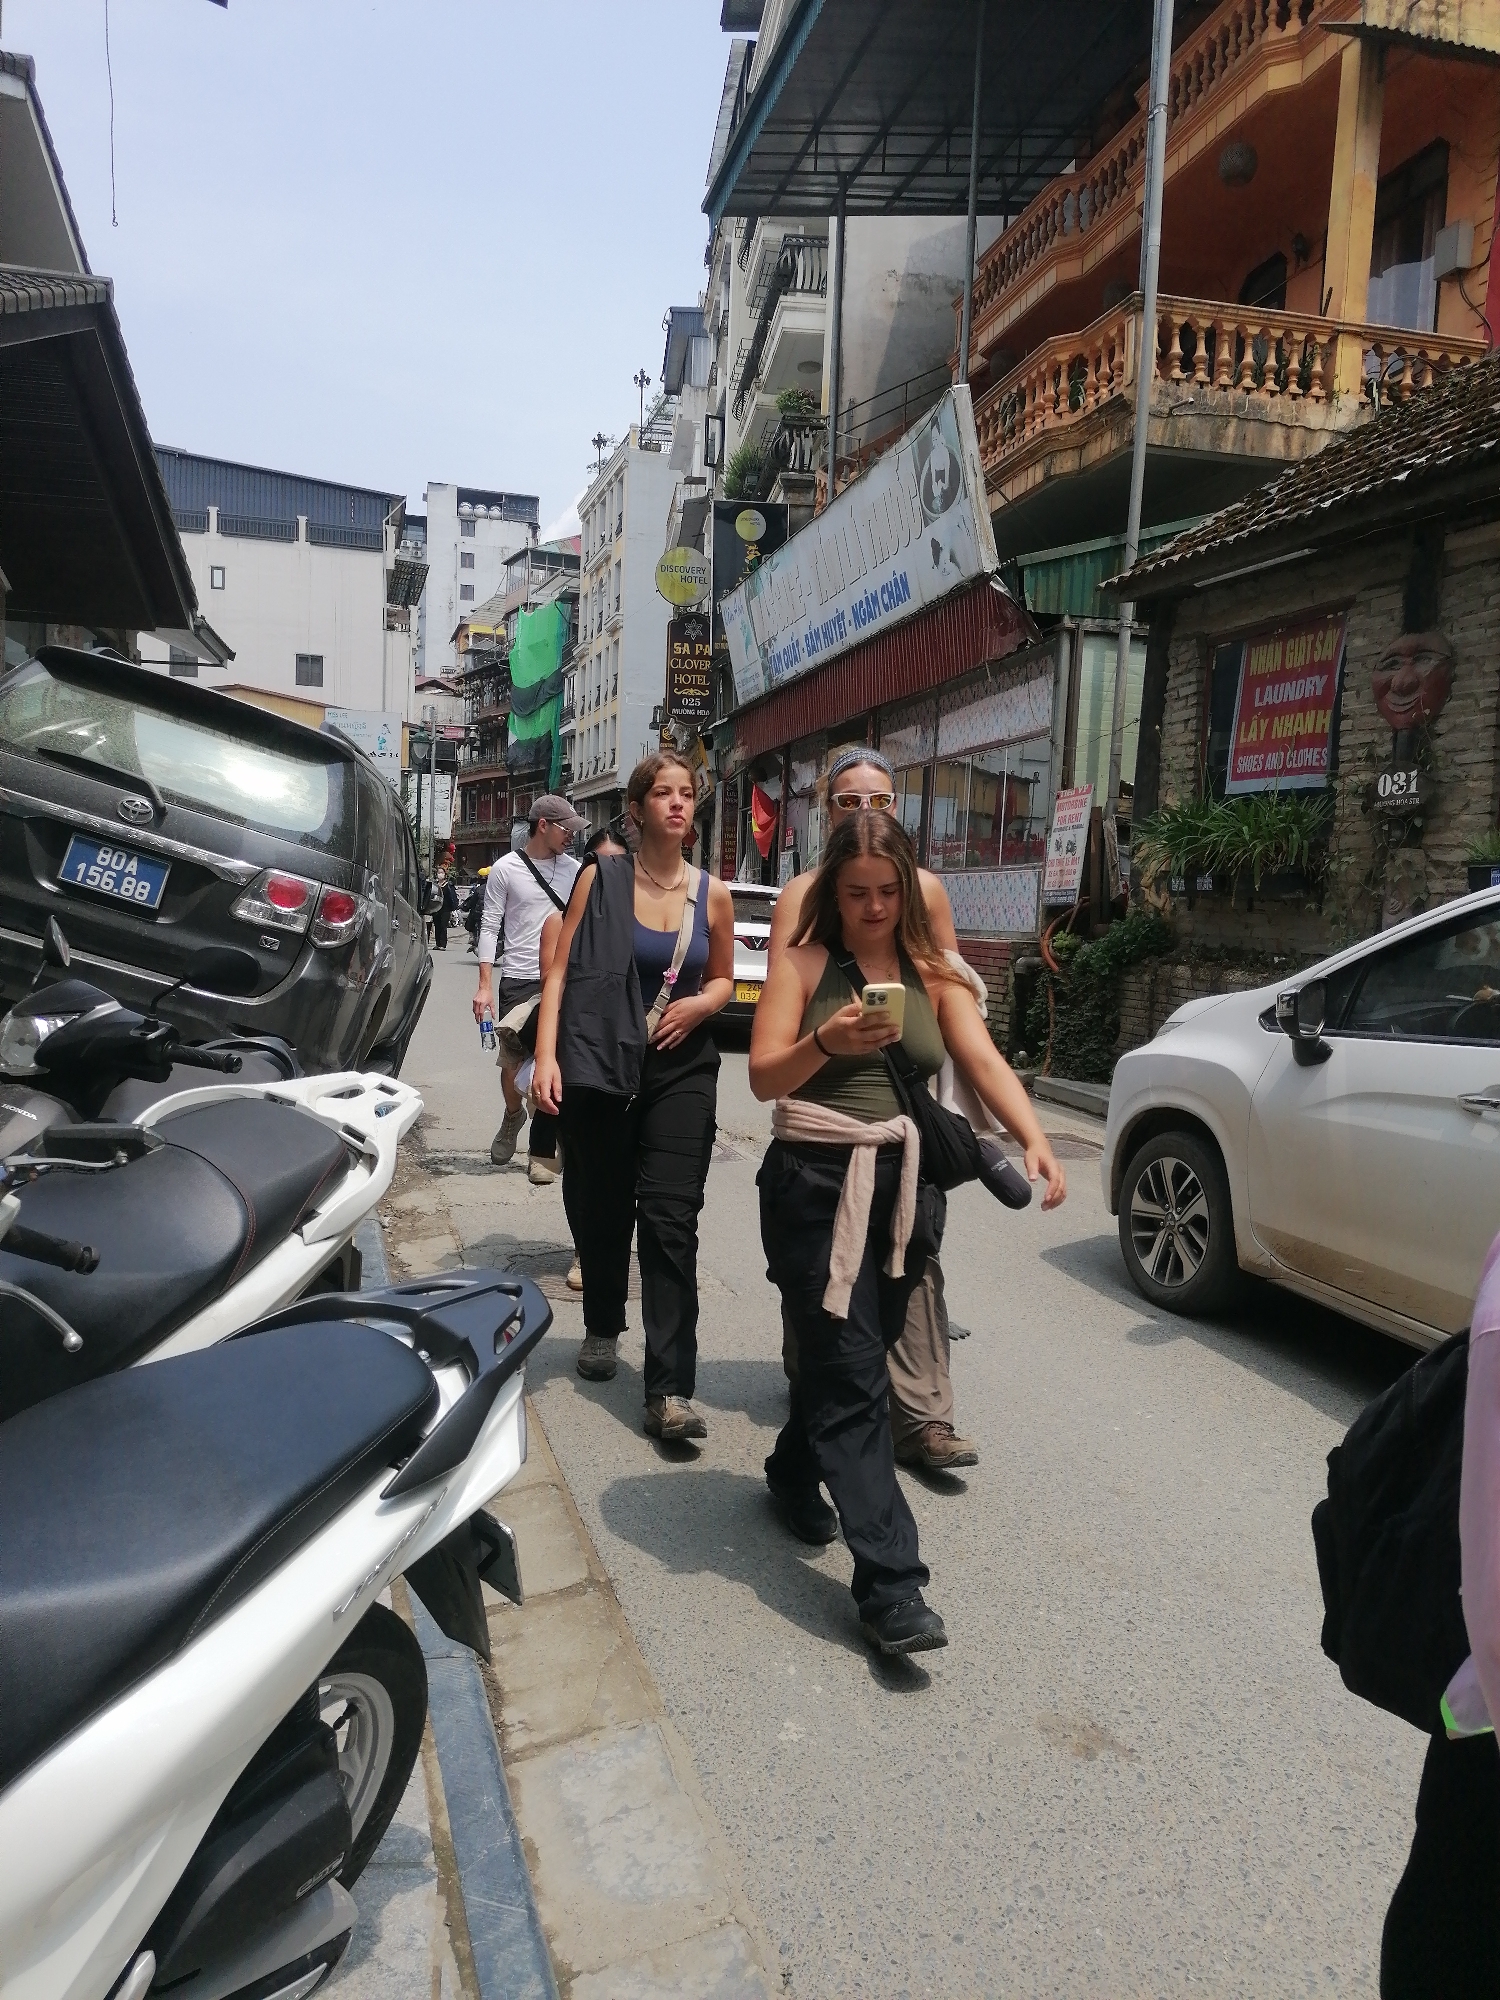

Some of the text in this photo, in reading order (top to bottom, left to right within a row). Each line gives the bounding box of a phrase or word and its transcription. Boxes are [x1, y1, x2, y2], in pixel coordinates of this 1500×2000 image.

[660, 564, 707, 575] DISCOVERY
[680, 575, 709, 585] HOTEL
[851, 588, 881, 632] NGÂM
[880, 570, 911, 613] CHÂN
[673, 642, 691, 655] SA
[695, 643, 711, 656] PA
[1249, 639, 1283, 679] NHẬN
[670, 658, 711, 671] CLOVER
[674, 673, 710, 686] HOTEL
[1254, 674, 1329, 708] LAUNDRY
[681, 698, 701, 707] 025
[1240, 709, 1333, 744] LẤY NHANH
[1236, 753, 1264, 774] SHOES
[1264, 751, 1285, 771] AND
[1377, 769, 1419, 797] 031
[1067, 812, 1083, 824] RENT
[96, 847, 139, 876] 80A
[76, 862, 151, 901] 156.88
[1, 1103, 38, 1121] HONDA
